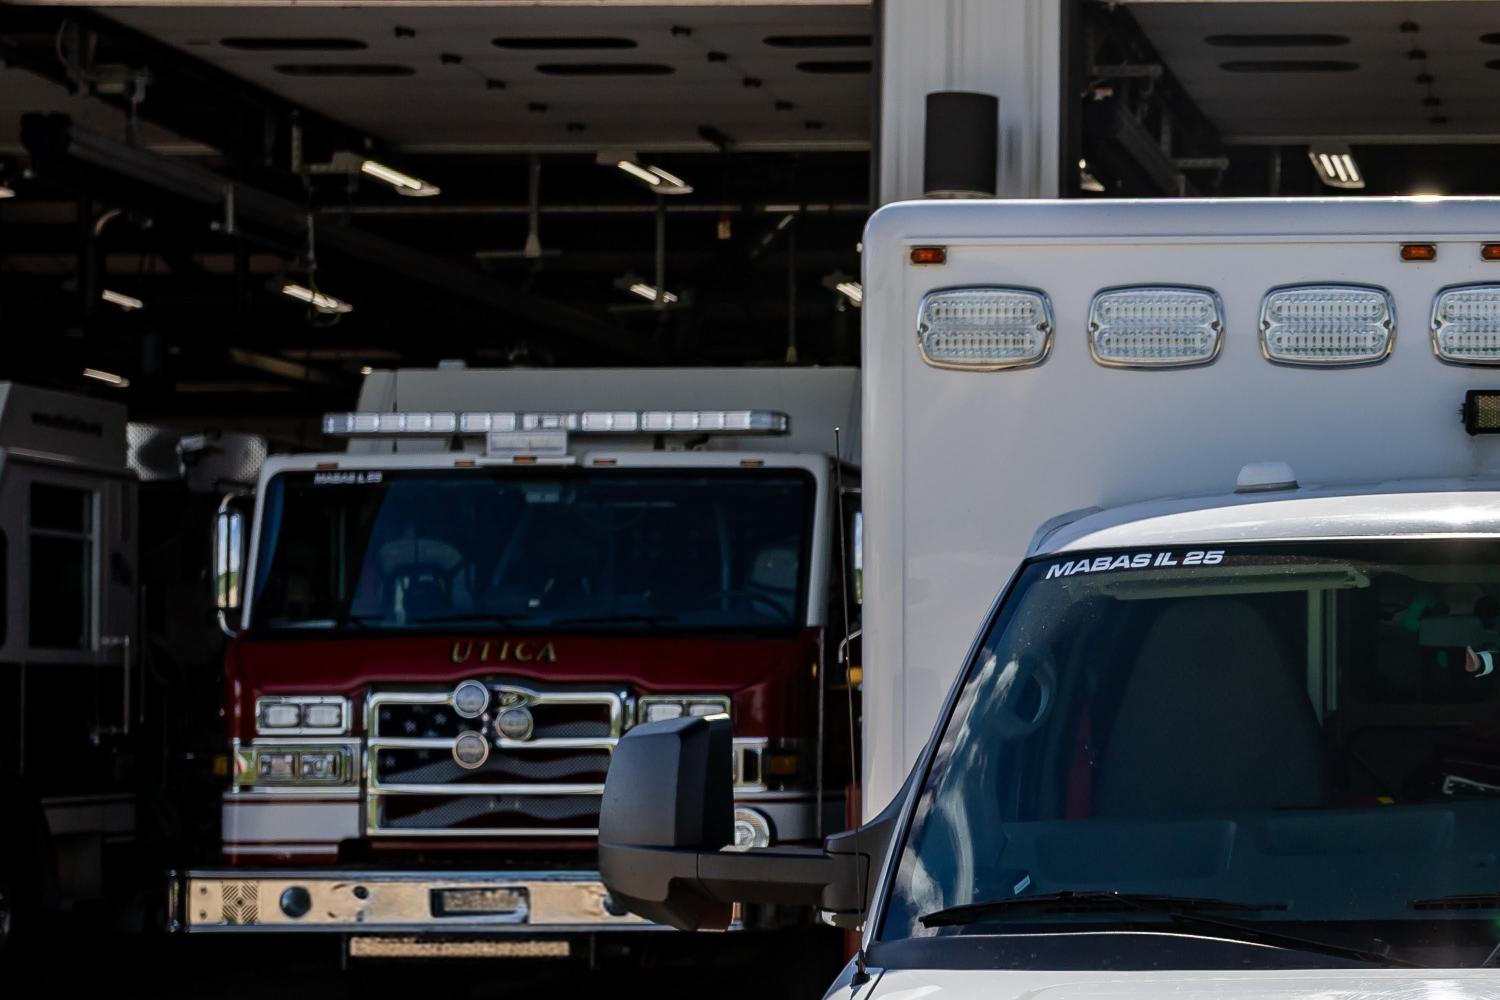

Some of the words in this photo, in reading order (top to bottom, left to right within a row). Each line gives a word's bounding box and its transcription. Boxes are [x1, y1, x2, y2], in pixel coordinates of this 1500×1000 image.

[1045, 556, 1150, 580] MABAS
[1153, 552, 1177, 567] IL
[1182, 550, 1225, 565] 25
[451, 639, 558, 663] UTICA
